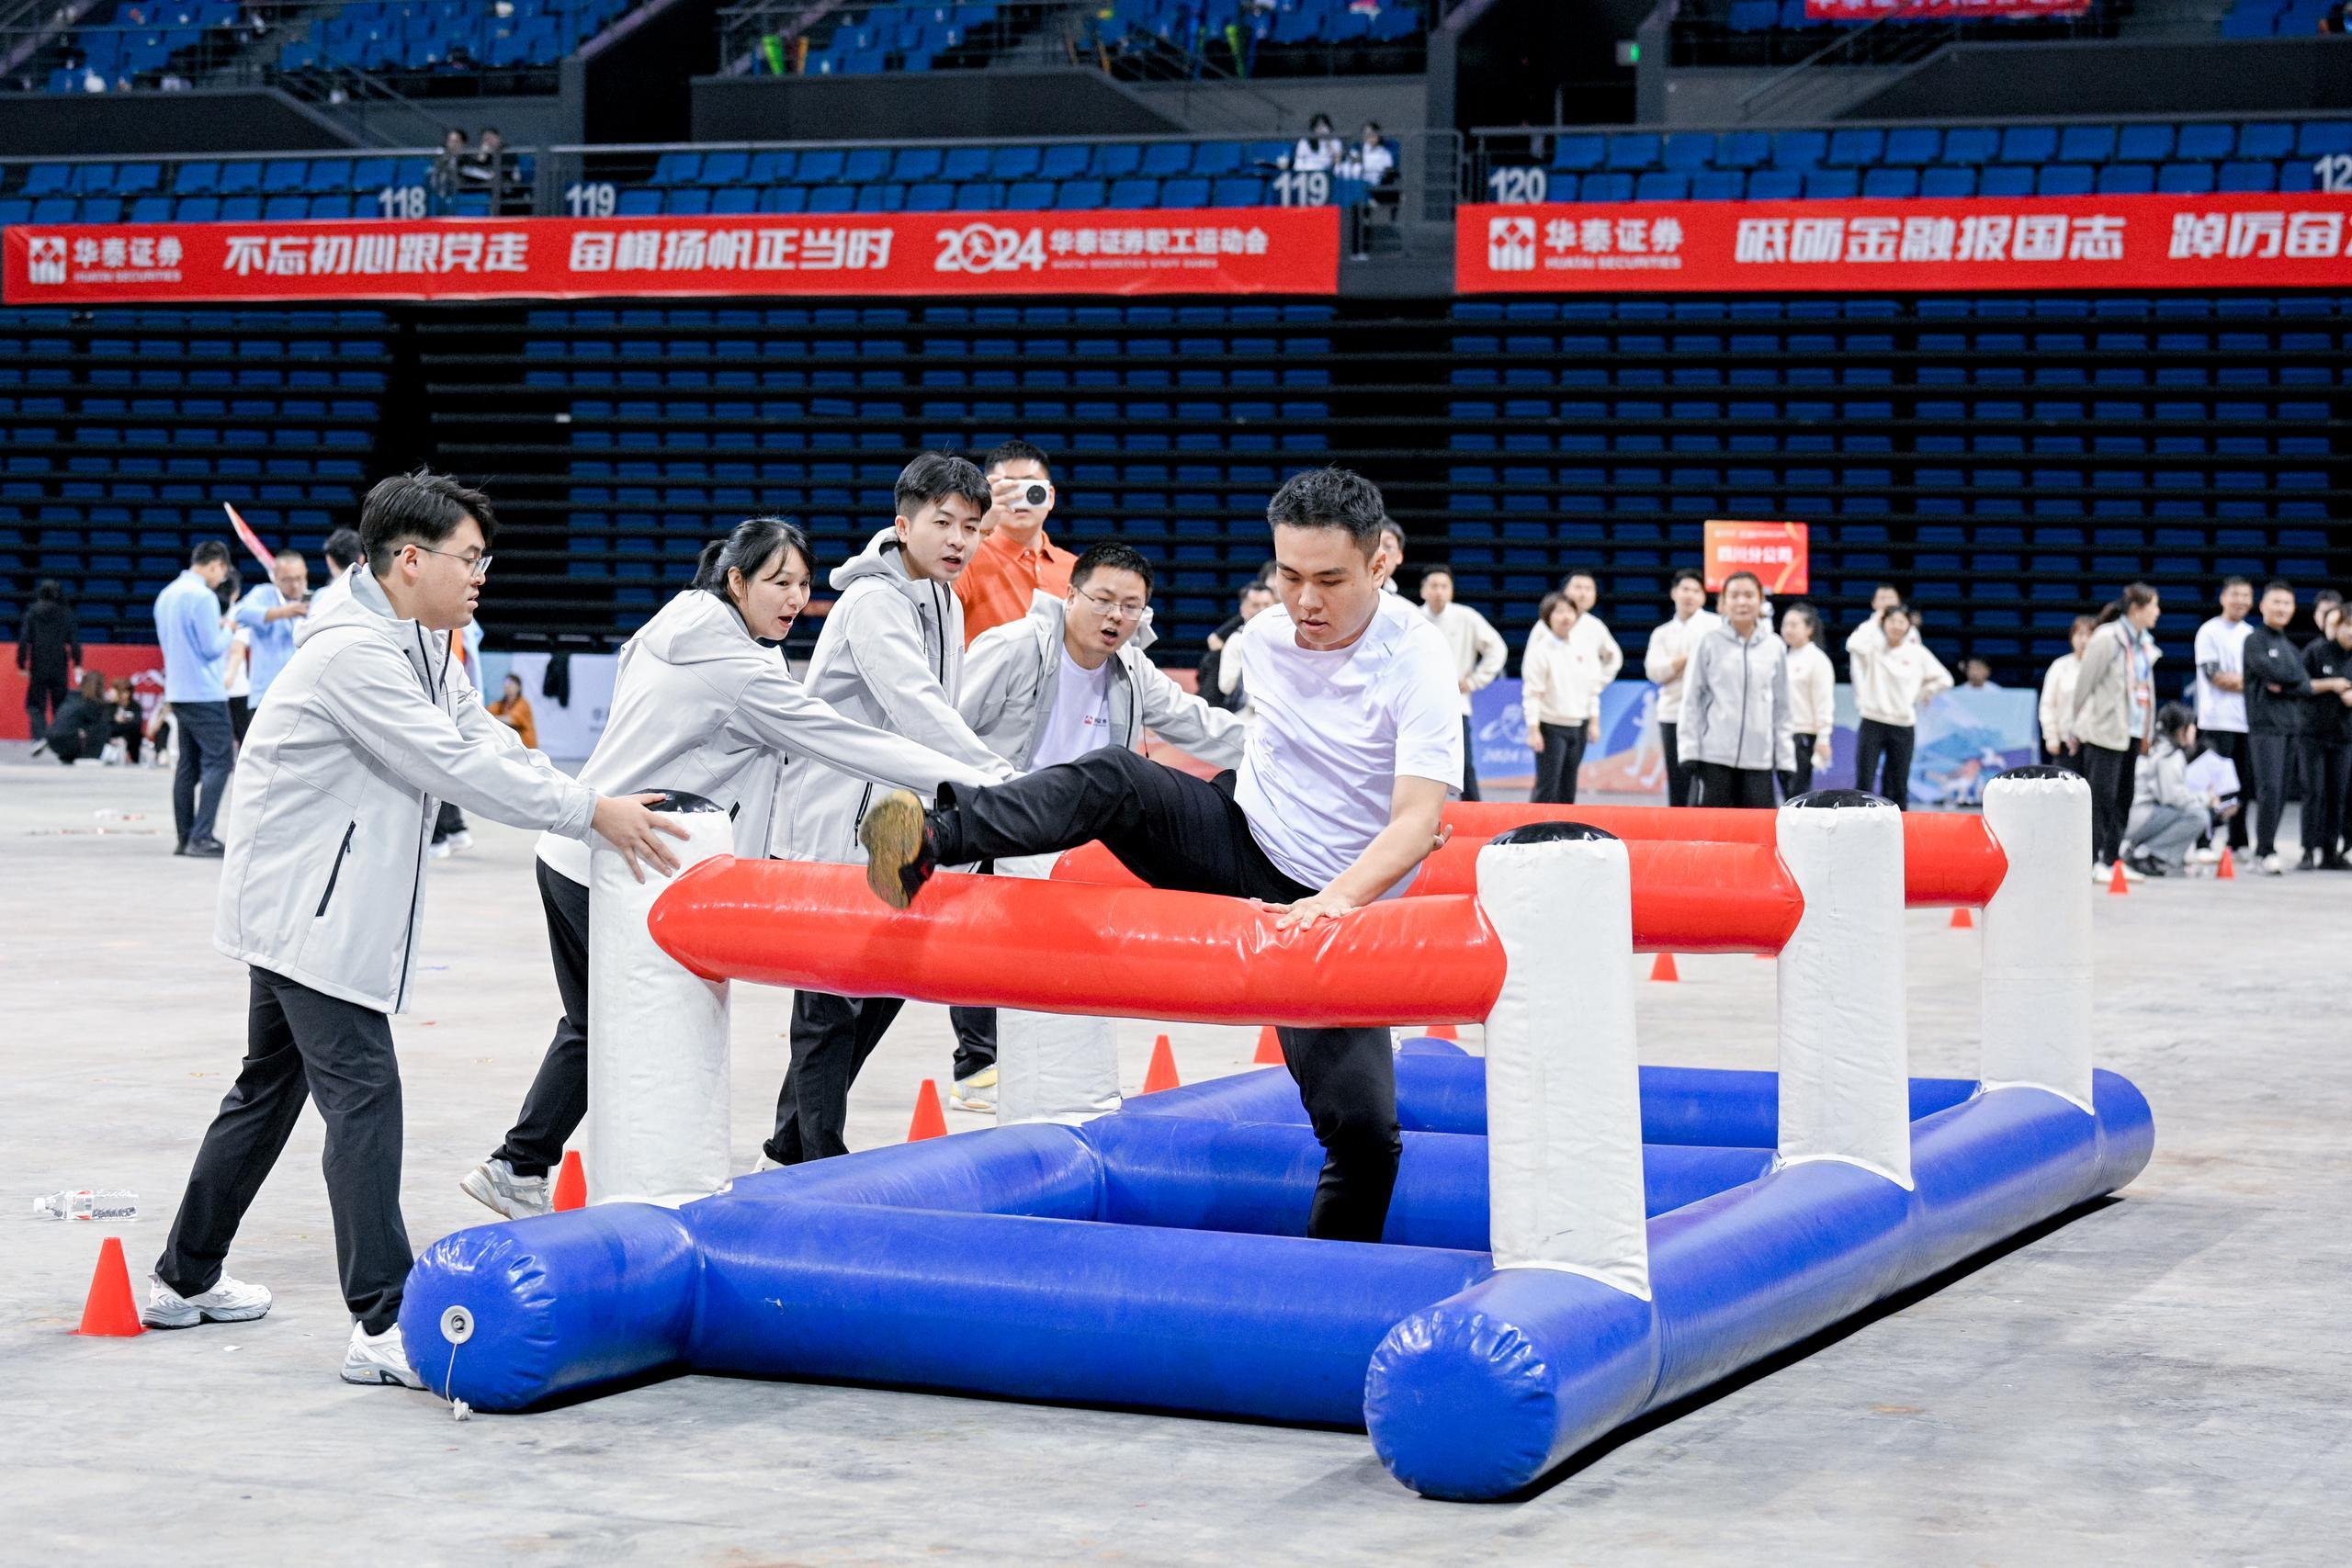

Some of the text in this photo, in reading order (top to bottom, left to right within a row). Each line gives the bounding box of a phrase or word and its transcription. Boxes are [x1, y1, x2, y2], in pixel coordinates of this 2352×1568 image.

[379, 186, 426, 219] 118
[566, 184, 616, 217] 119
[1272, 171, 1329, 208] 119
[1489, 168, 1546, 203] 120
[74, 236, 183, 268] 华泰证券
[569, 229, 894, 272] 奋楫扬帆正当时
[934, 222, 1268, 274] 2024 华泰证券职工运动会
[1544, 217, 1684, 254] 华泰证券
[1735, 215, 2126, 263] 砥砺金融报国志
[2168, 211, 2352, 259] 踔厉奋
[223, 232, 529, 276] 不忘初心跟党走
